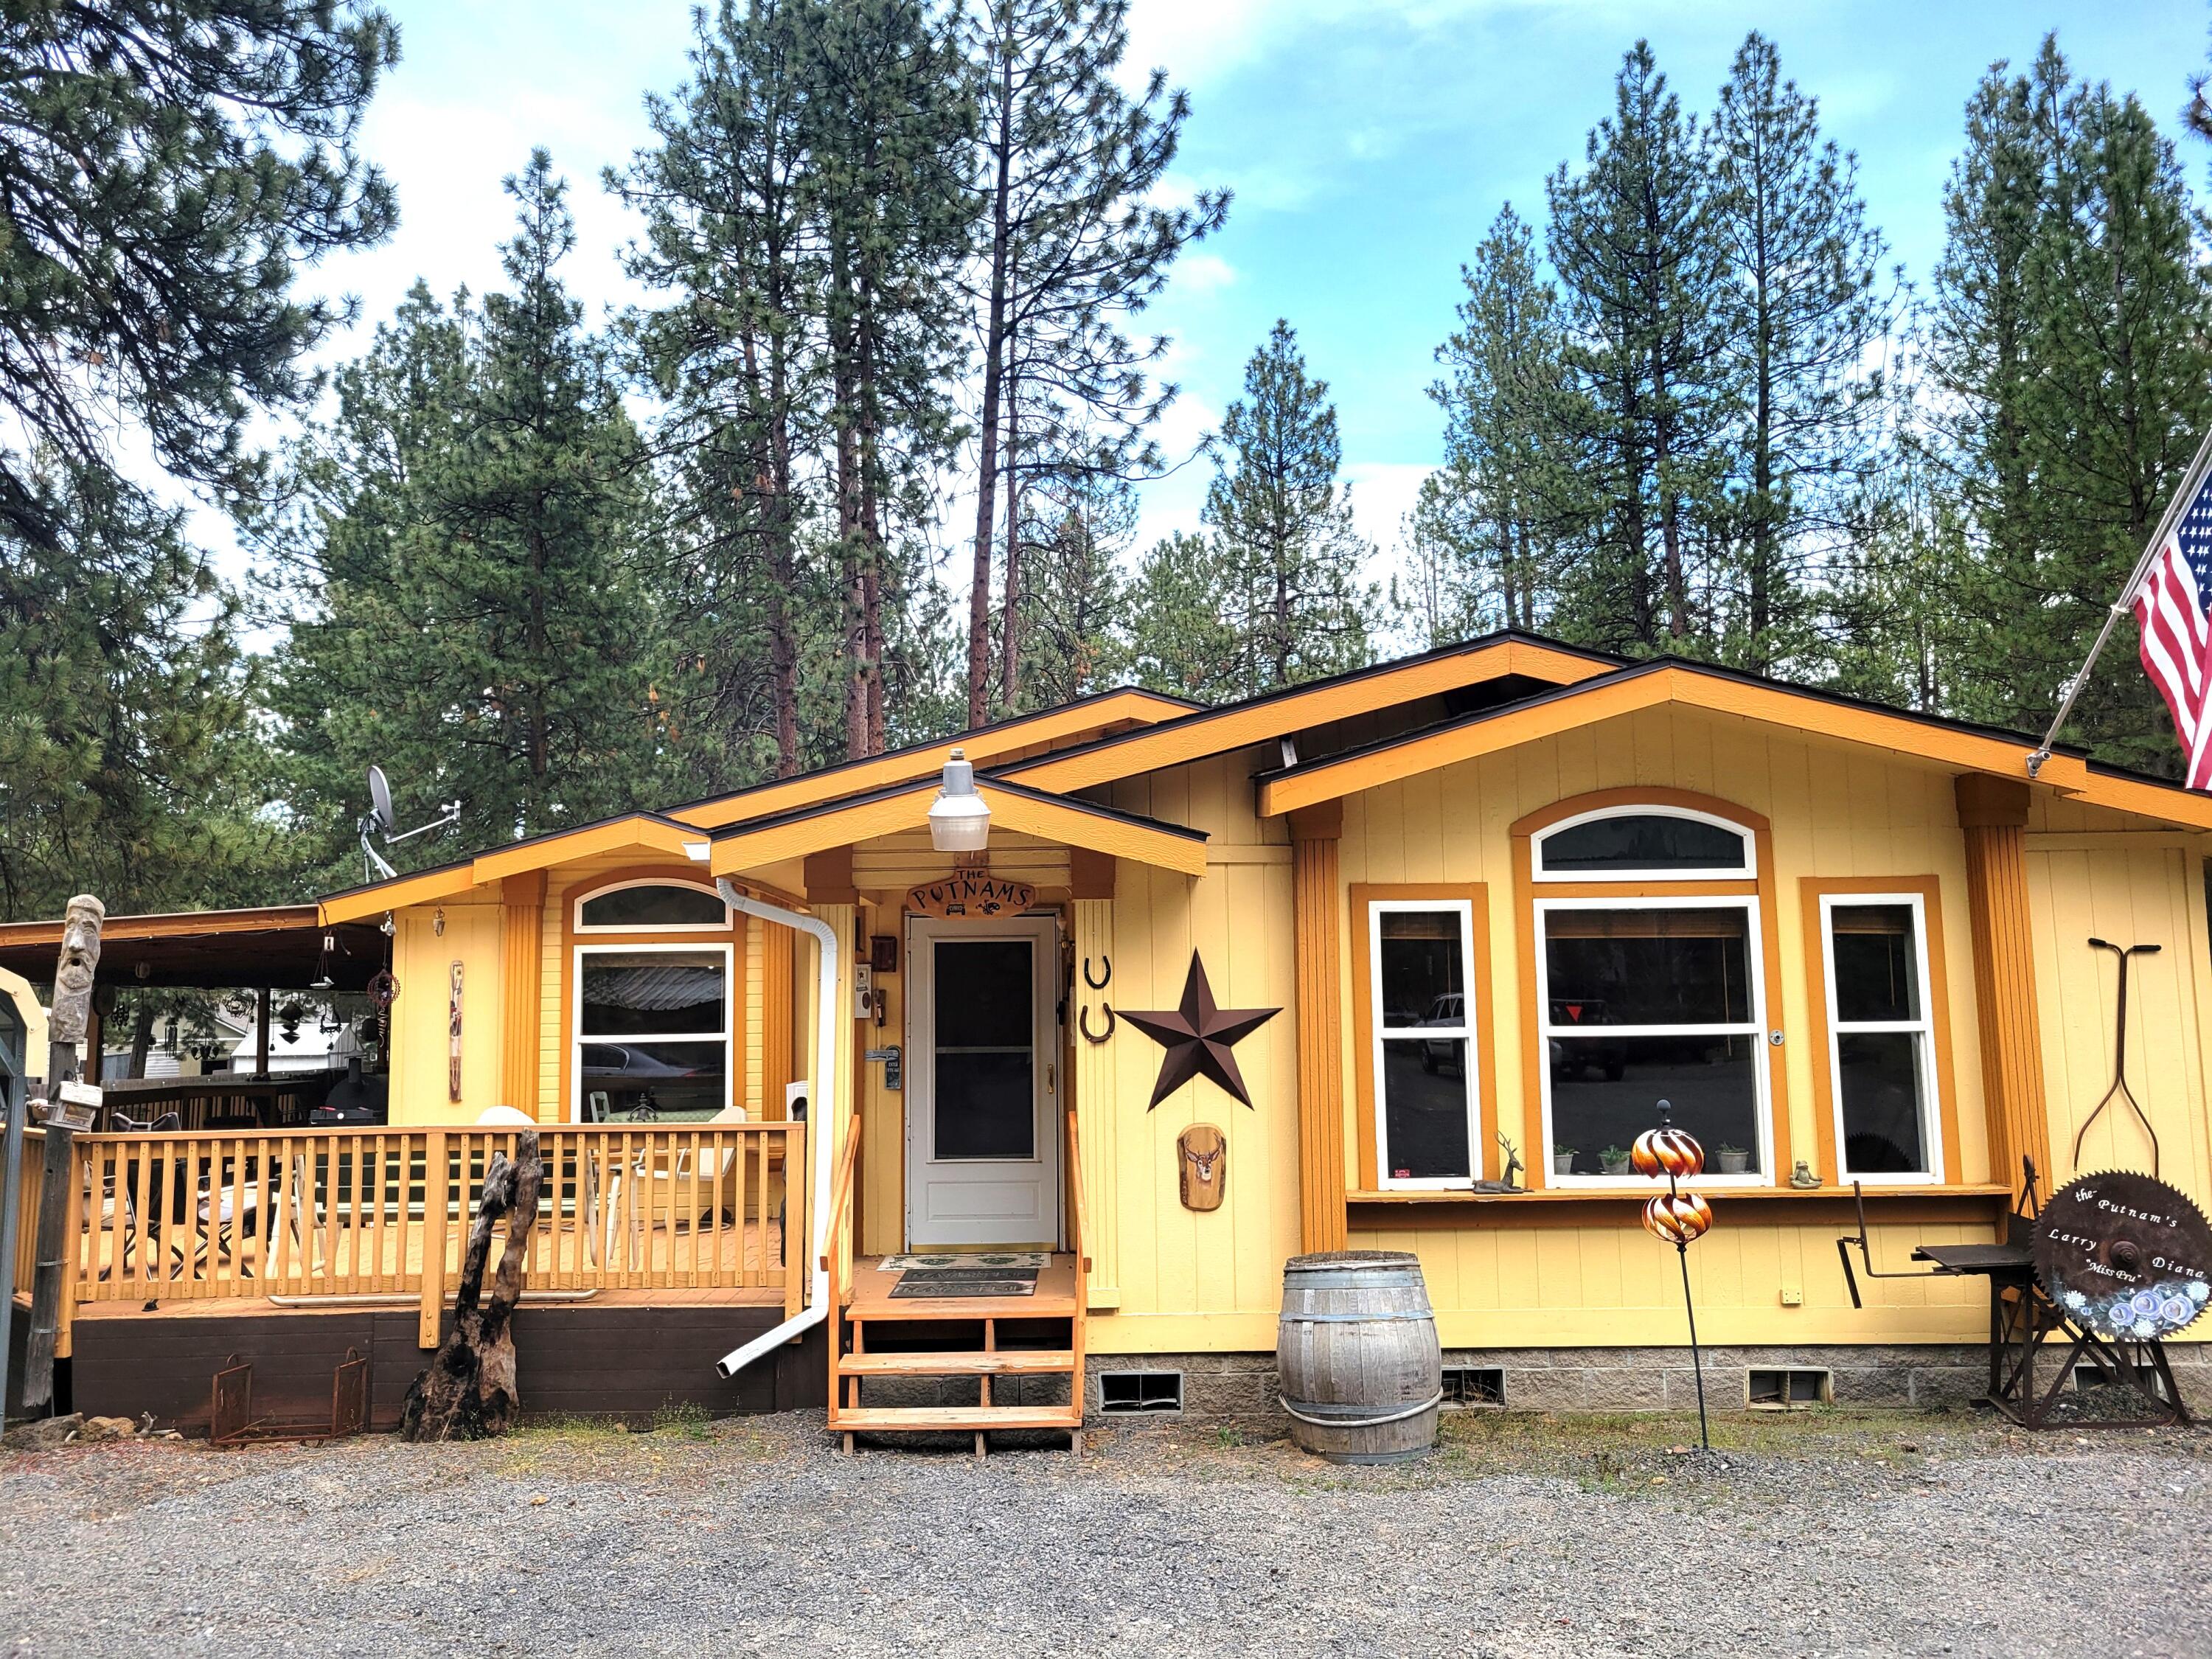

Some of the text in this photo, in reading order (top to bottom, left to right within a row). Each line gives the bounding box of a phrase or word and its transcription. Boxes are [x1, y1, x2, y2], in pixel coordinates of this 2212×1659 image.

[957, 870, 984, 880] THE
[912, 880, 1031, 908] PUTNAMS
[2098, 1200, 2177, 1227] Putnam's
[2048, 1229, 2096, 1251] Larry
[2152, 1257, 2204, 1278] Diana
